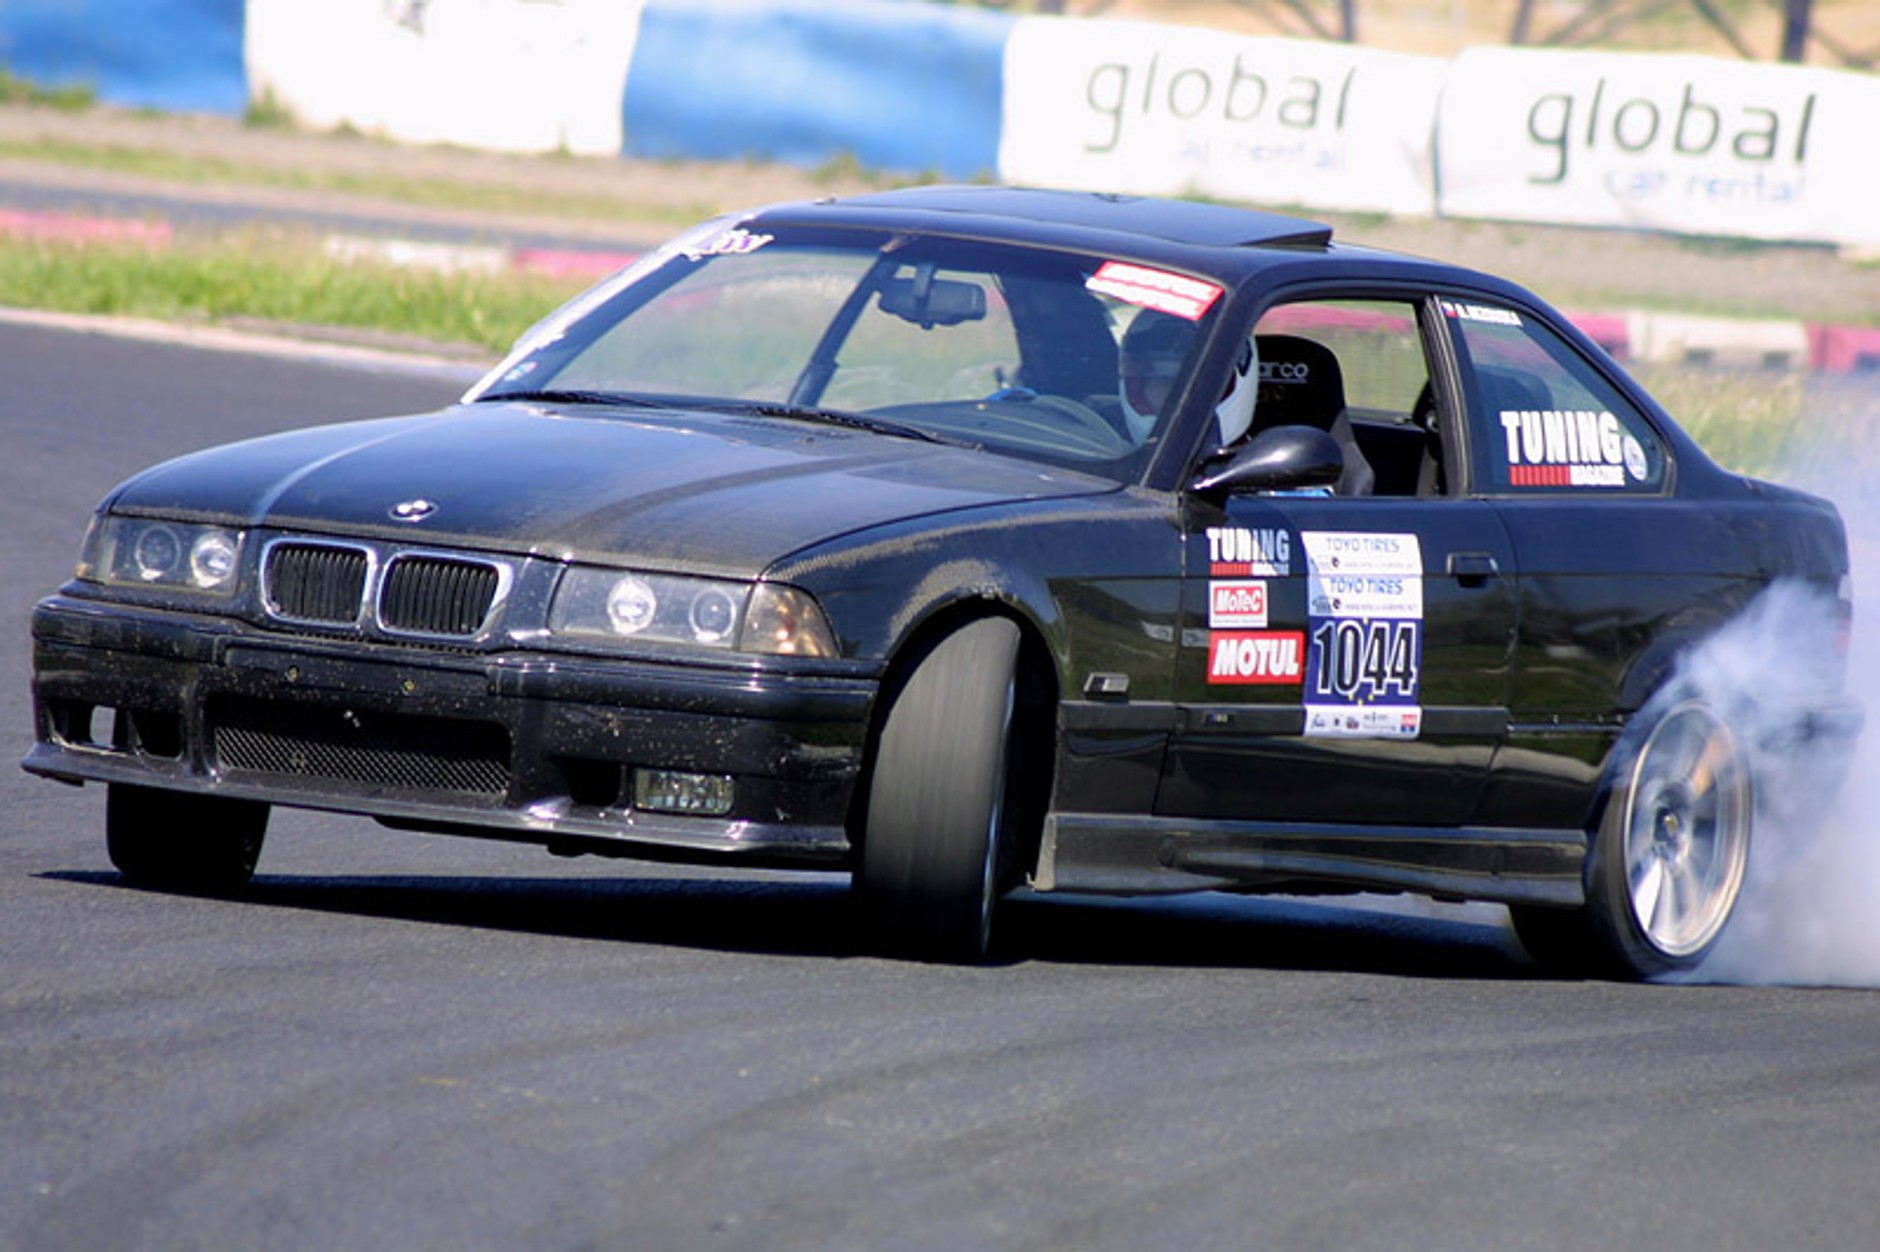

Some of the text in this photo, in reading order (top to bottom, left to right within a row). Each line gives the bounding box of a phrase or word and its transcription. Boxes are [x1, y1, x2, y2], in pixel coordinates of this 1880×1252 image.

[1084, 51, 1356, 152] global
[1526, 77, 1816, 184] global
[1500, 411, 1624, 465] TUNING
[1206, 528, 1290, 562] TUNING
[1326, 537, 1400, 553] TOYO TIRES
[1214, 589, 1263, 613] MoTeC
[1329, 578, 1404, 595] TOYO TIRES
[1212, 638, 1299, 676] MOTUL
[1313, 620, 1418, 696] 1044
